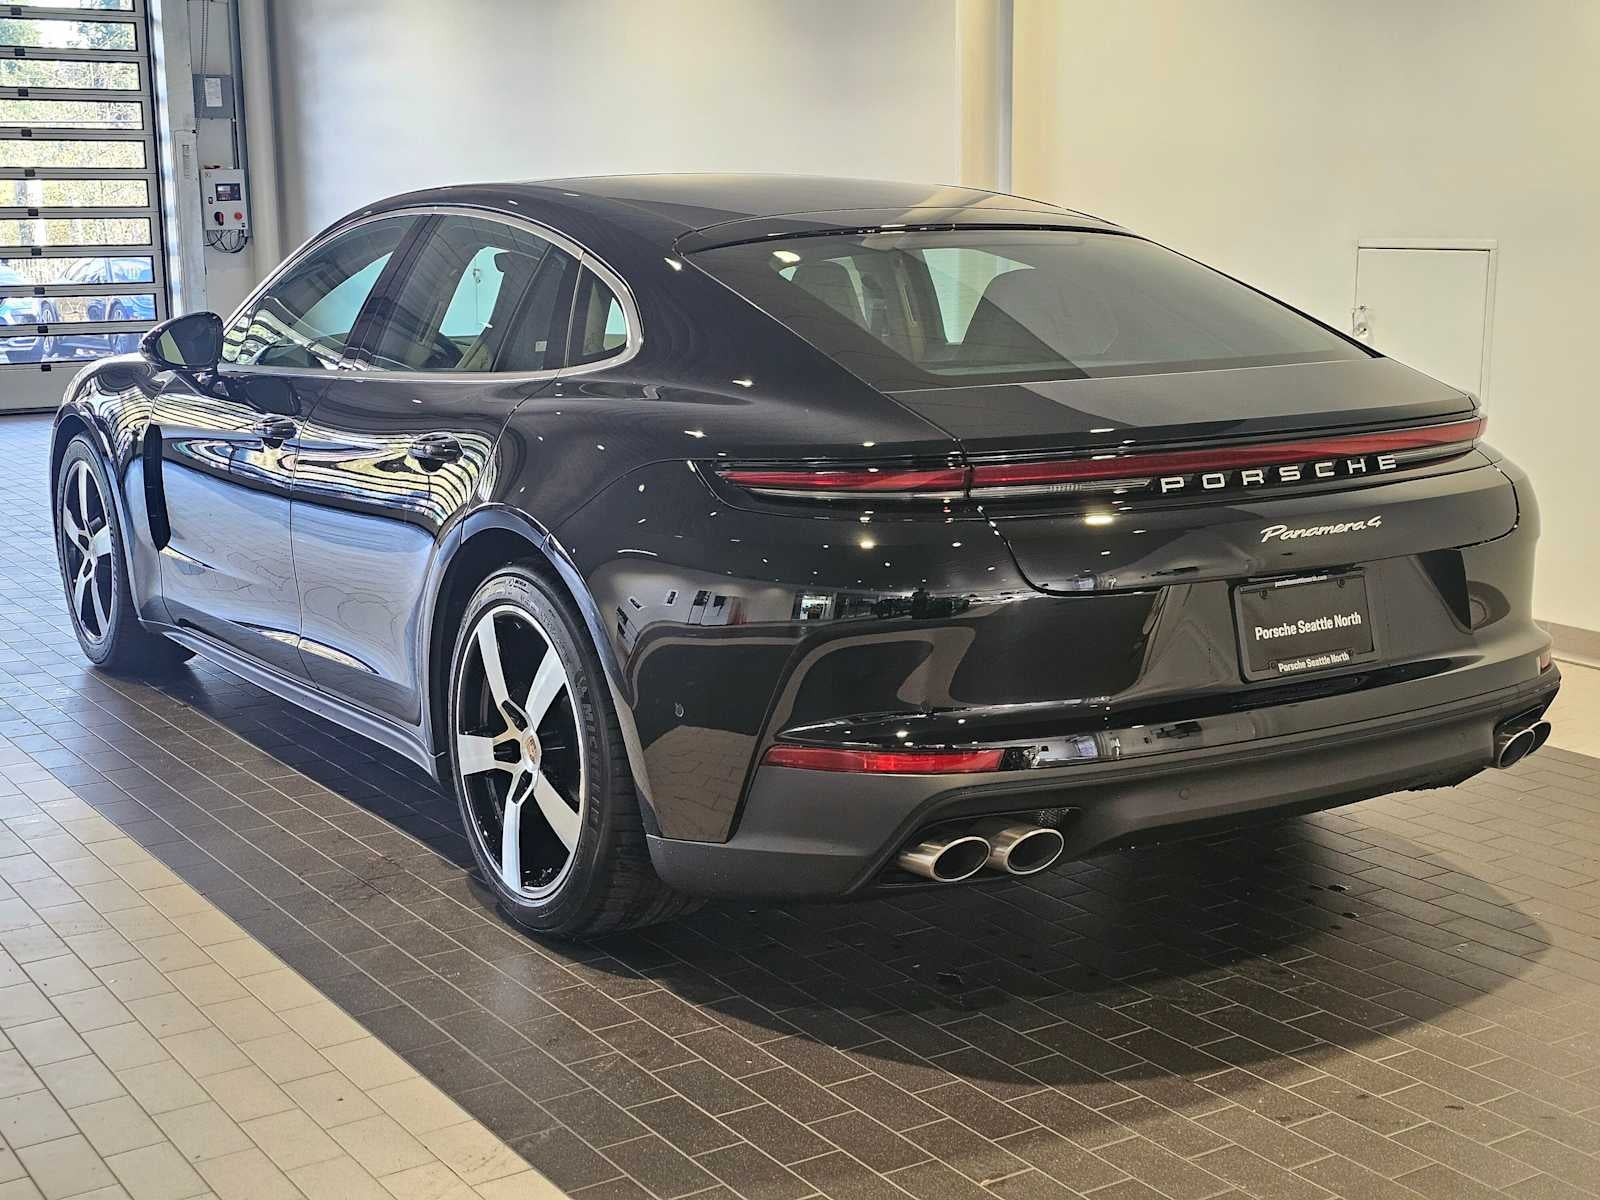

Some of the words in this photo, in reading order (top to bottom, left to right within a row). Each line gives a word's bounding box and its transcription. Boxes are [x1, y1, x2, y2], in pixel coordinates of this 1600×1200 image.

[1160, 454, 1397, 493] PORSCHE
[1260, 520, 1367, 543] Panamera
[1255, 622, 1297, 641] Porsche
[1297, 616, 1334, 634] Seattle
[1333, 611, 1362, 629] North
[1278, 660, 1306, 673] Porsche
[1306, 655, 1331, 668] Seattle
[1330, 651, 1350, 664] North
